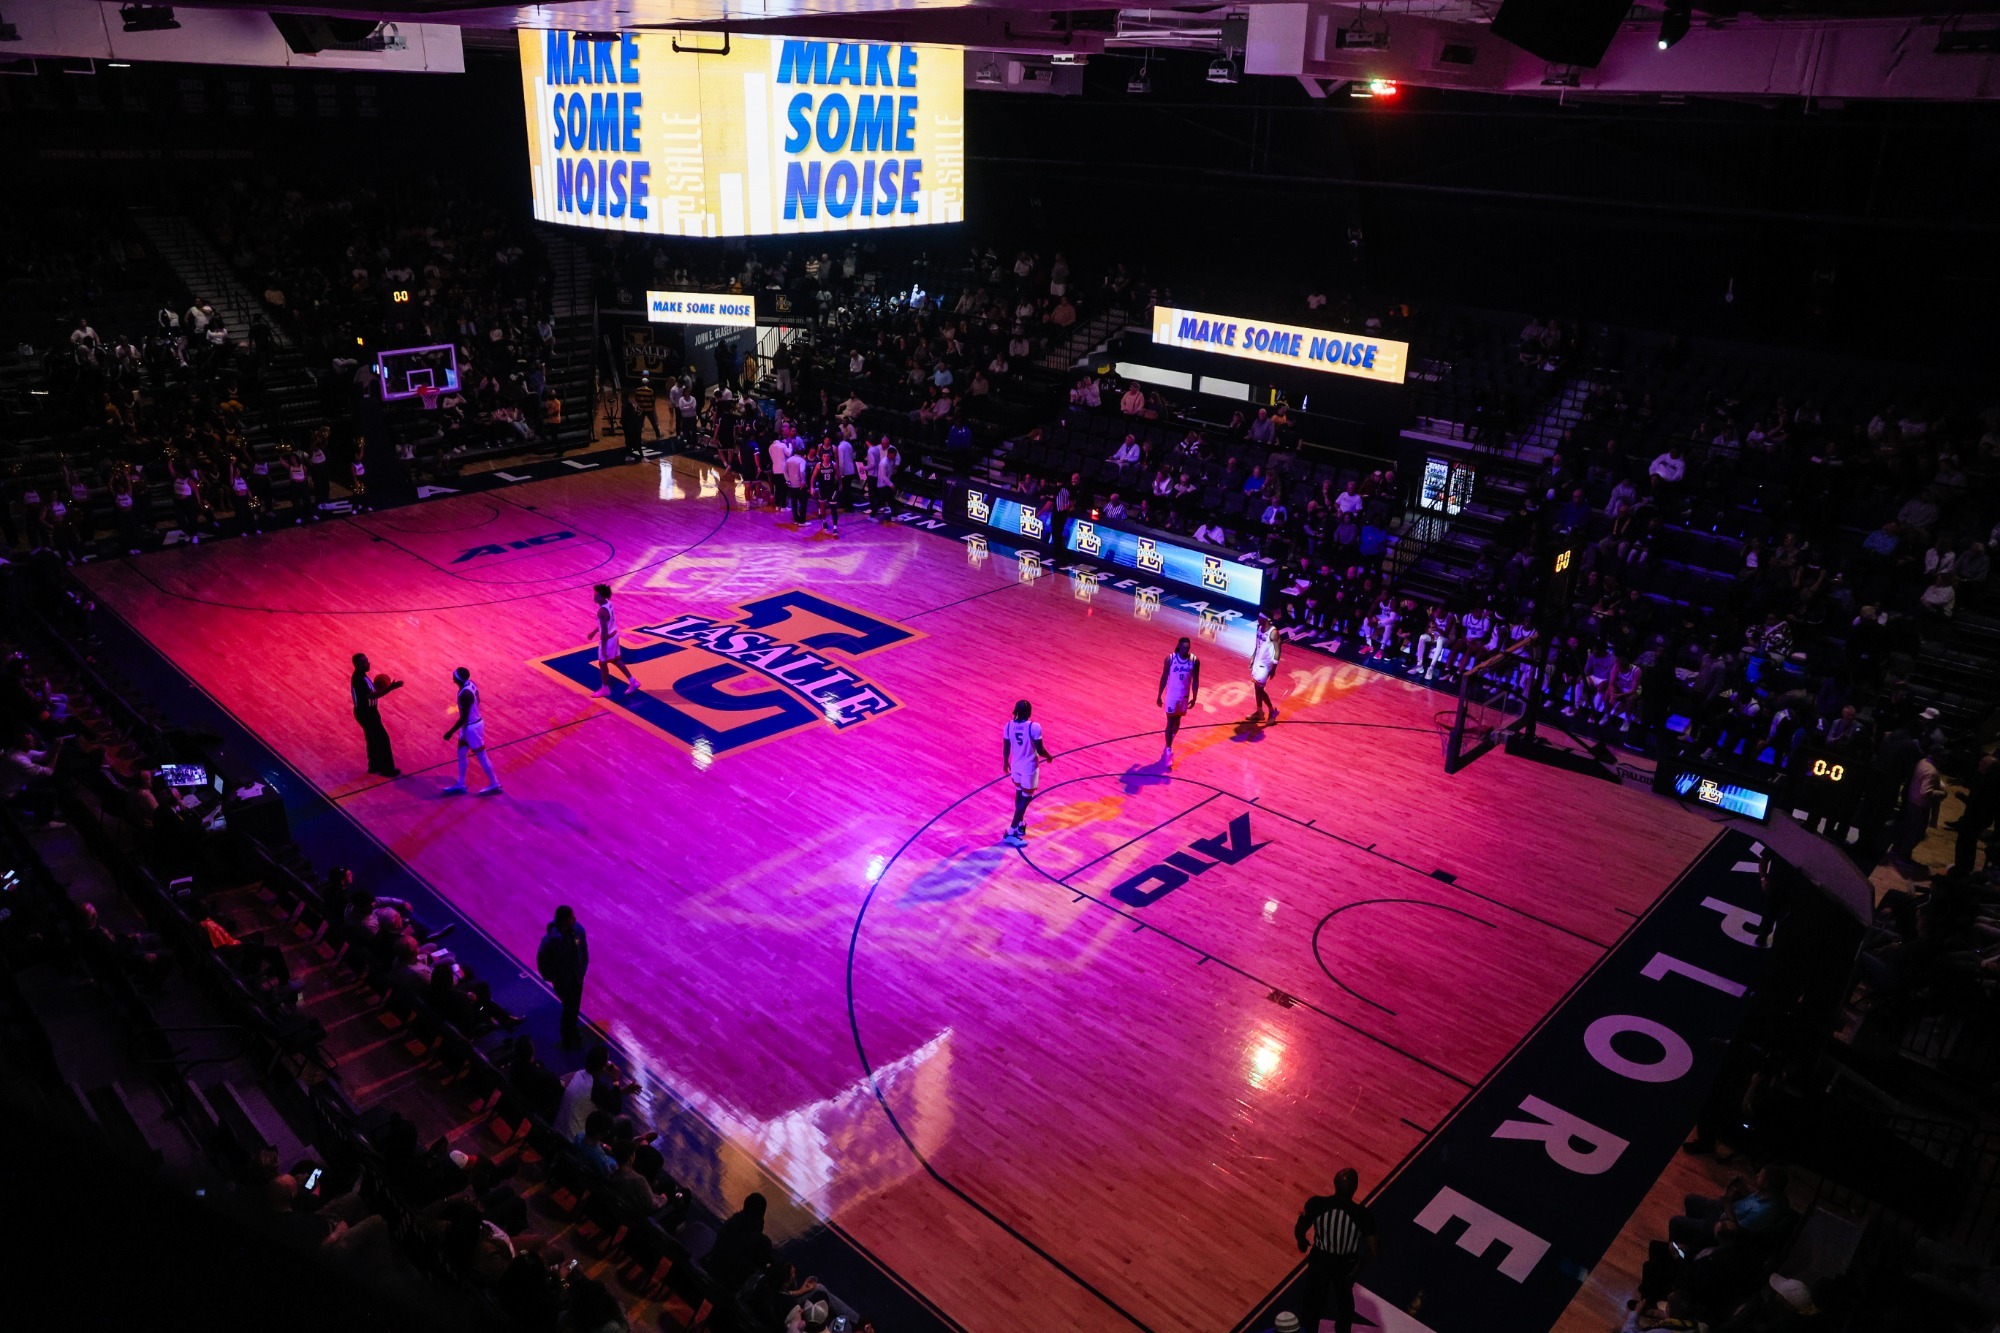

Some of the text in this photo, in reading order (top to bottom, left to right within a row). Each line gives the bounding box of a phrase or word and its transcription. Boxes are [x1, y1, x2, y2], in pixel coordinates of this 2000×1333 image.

[547, 31, 640, 85] MAKE
[776, 40, 918, 87] MAKE
[554, 92, 642, 152] SOME
[785, 92, 918, 153] SOME
[557, 158, 650, 220] NOISE
[784, 158, 922, 220] NOISE
[653, 301, 750, 316] MAKE SOME NOISE
[1178, 317, 1237, 346] MAKE
[1242, 327, 1303, 357] SOME
[1308, 336, 1377, 369] NOISE
[1015, 732, 1024, 747] 5
[1616, 766, 1654, 786] SPALDI
